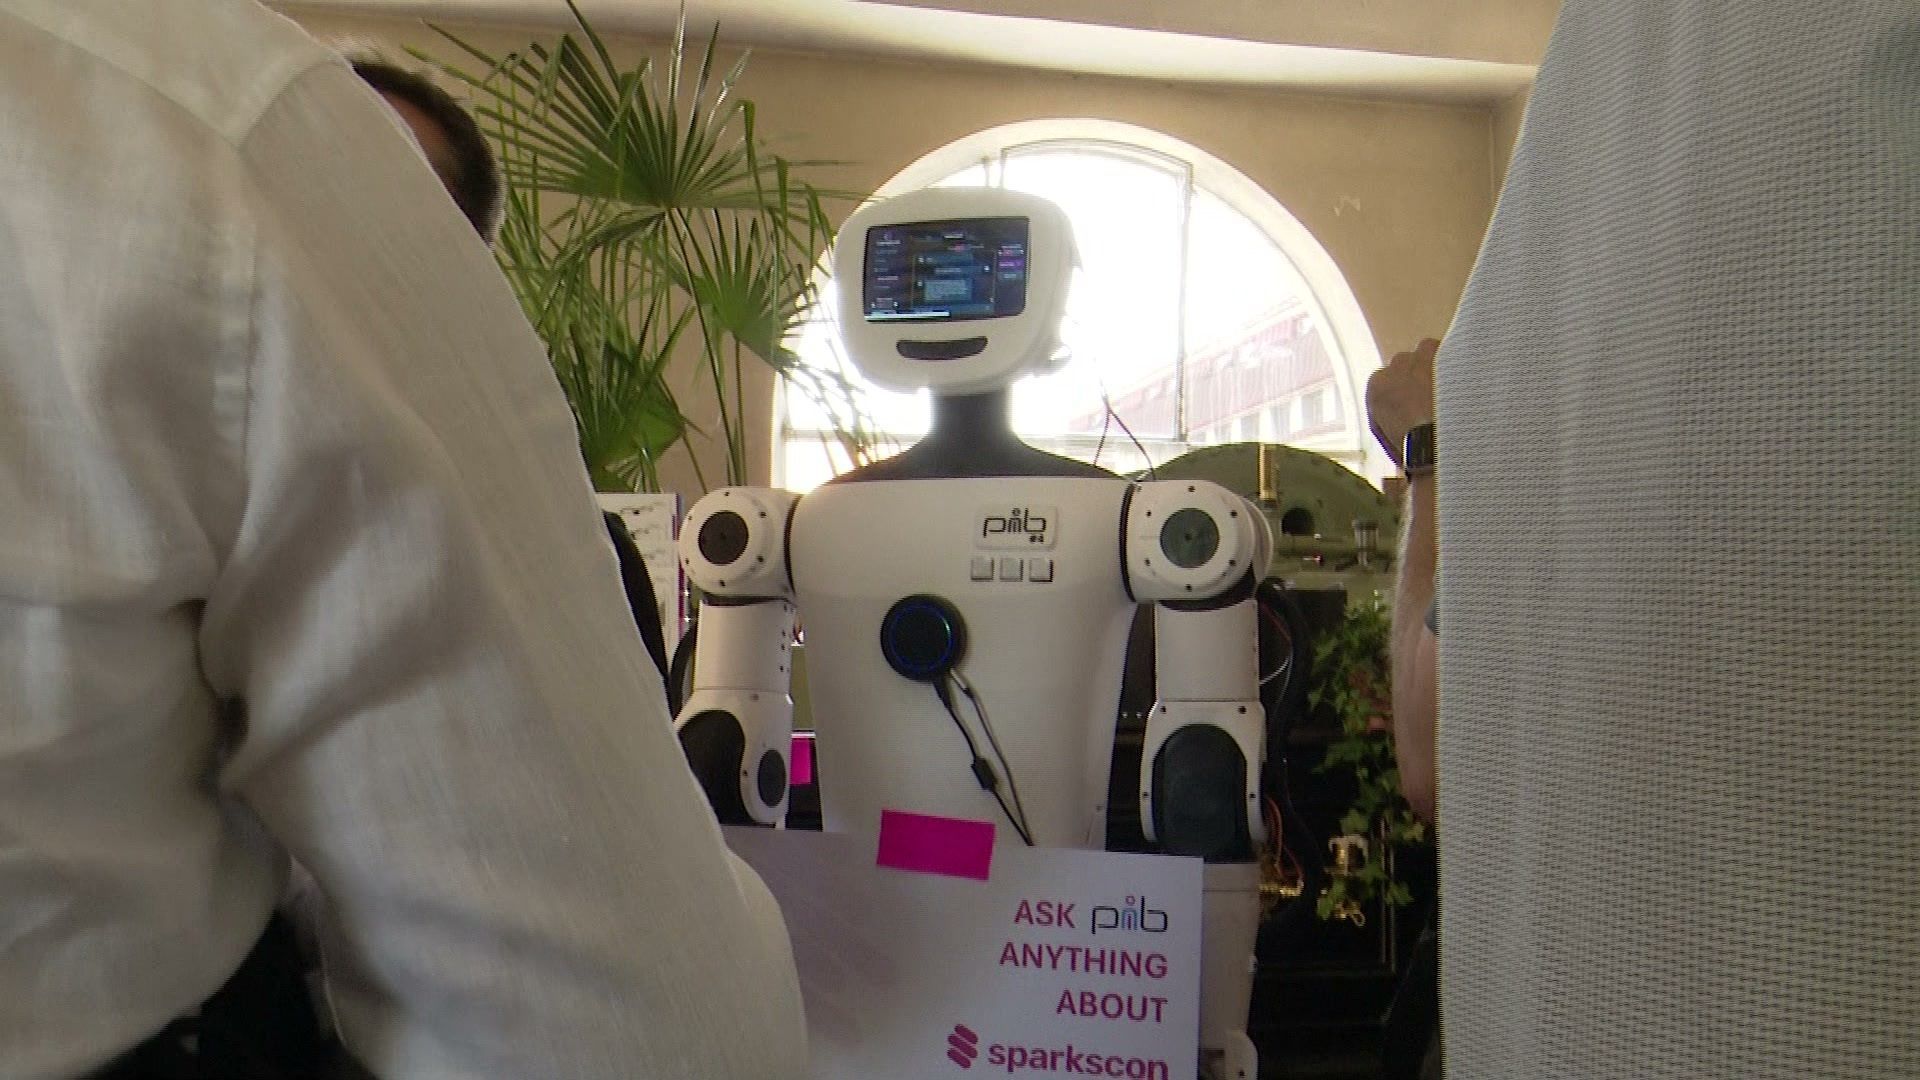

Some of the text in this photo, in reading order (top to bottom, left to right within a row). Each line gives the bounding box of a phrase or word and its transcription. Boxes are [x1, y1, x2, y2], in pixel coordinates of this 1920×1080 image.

[1014, 899, 1075, 929] ASK
[999, 941, 1168, 979] ANYTHING
[1056, 989, 1169, 1023] ABOUT
[988, 1043, 1169, 1080] sparkscon
